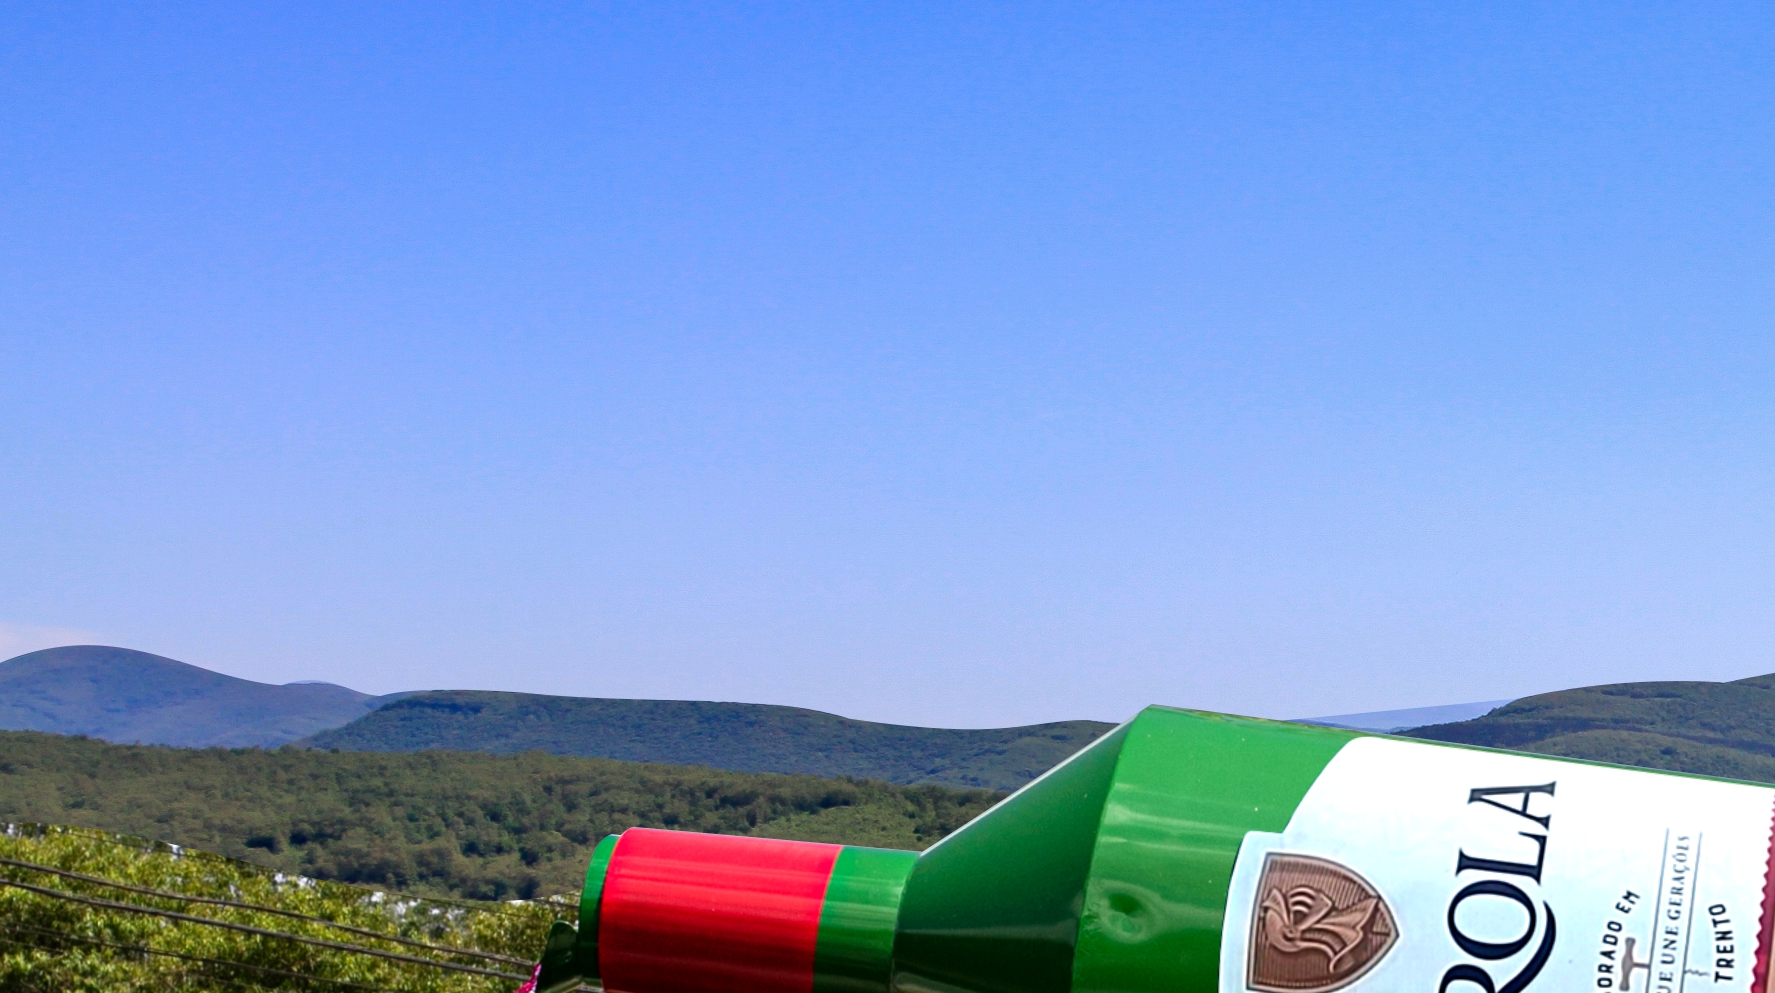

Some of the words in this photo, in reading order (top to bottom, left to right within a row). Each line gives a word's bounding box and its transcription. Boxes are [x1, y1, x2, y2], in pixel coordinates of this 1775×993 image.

[1615, 890, 1641, 914] EM
[1660, 926, 1679, 965] UNE
[1708, 903, 1735, 983] TRENTO
